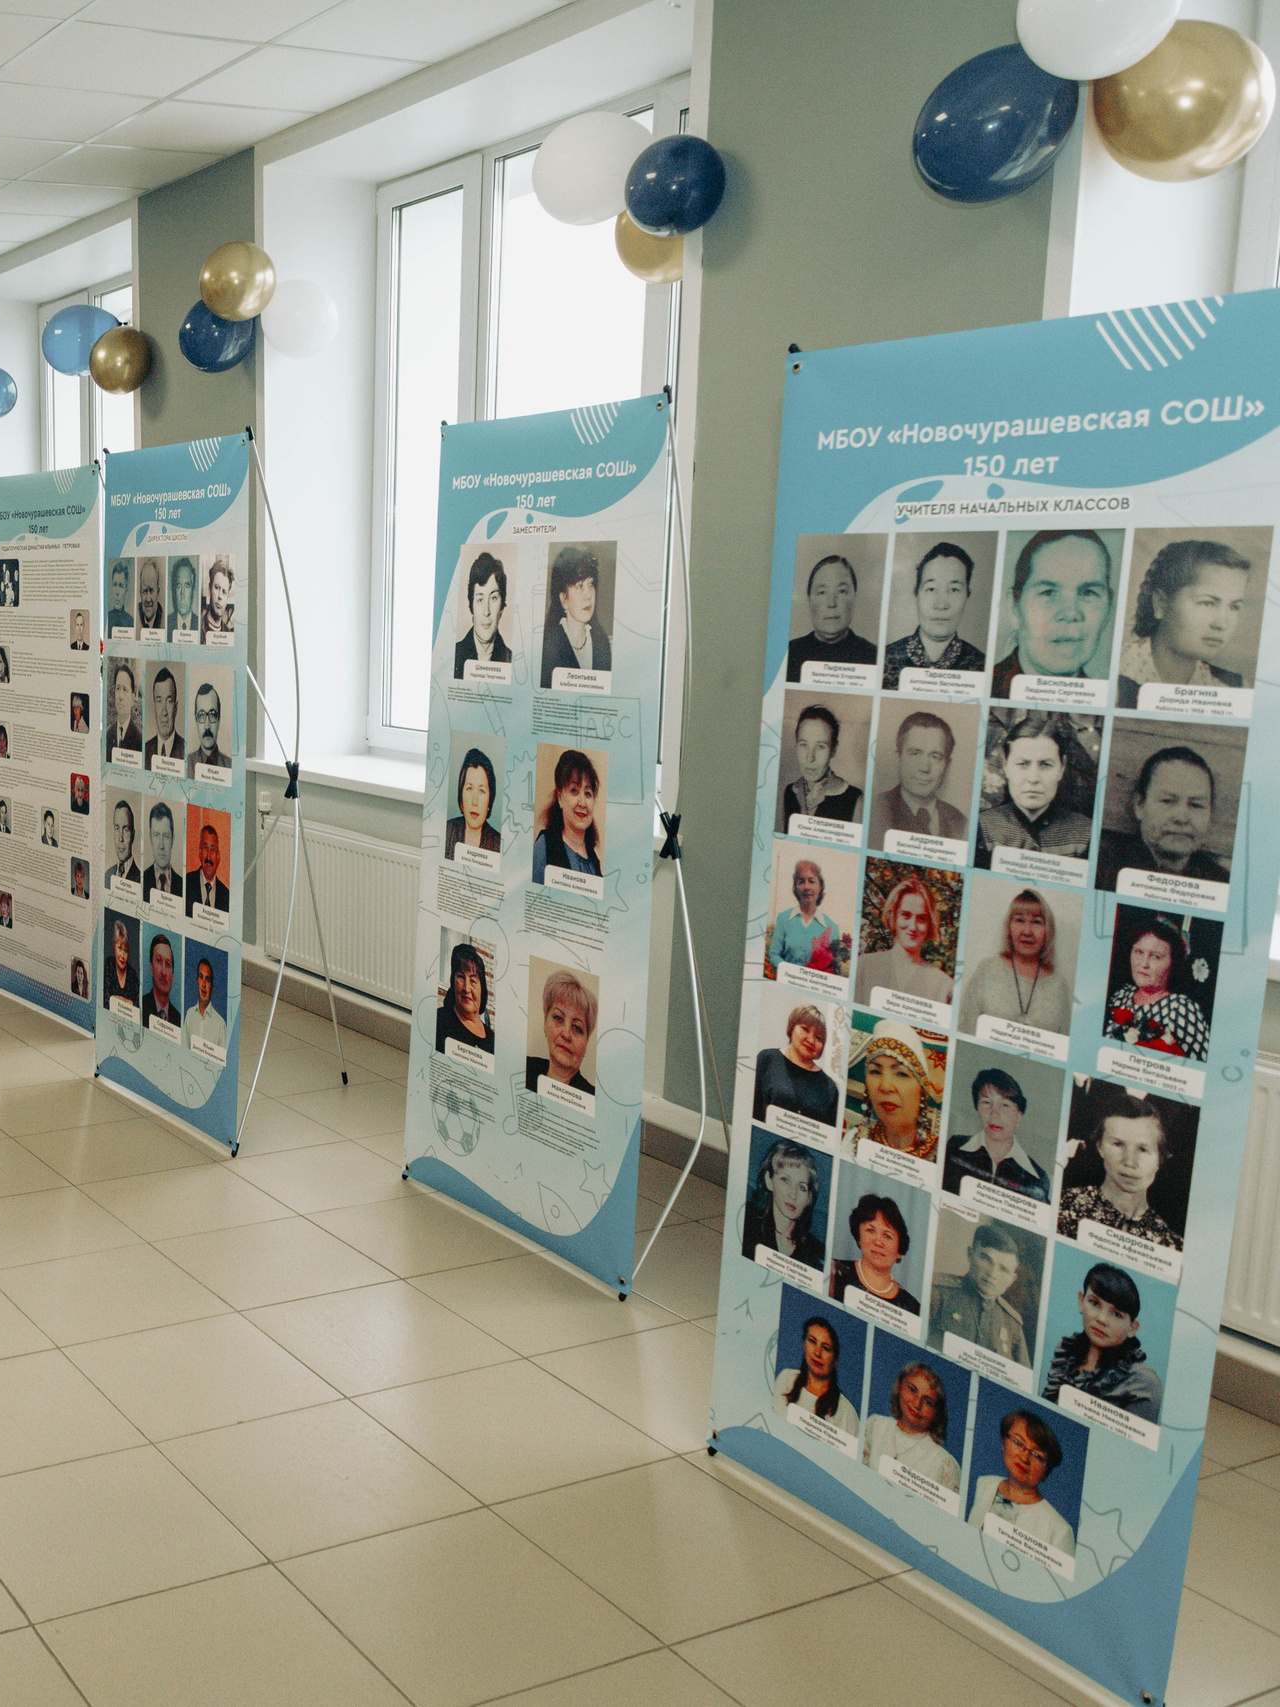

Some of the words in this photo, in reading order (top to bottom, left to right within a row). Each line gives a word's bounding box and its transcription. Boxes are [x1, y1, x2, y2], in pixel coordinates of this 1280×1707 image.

[817, 426, 882, 451] МБОУ
[887, 406, 1150, 446] «Новочурашевская
[1160, 396, 1265, 428] СОШ»
[964, 454, 1005, 478] 150
[1013, 452, 1060, 476] лет
[452, 474, 481, 490] МБОУ
[483, 466, 592, 488] «Новочурашевская
[596, 460, 637, 478] СОШ»
[111, 494, 131, 506] МБОУ
[132, 488, 205, 505] «Новочурашевская
[207, 483, 232, 498] СОШ»
[516, 495, 534, 508] 150
[536, 495, 556, 508] лет
[12, 506, 66, 521] «Новочурашевская
[66, 504, 86, 515] СОШ»
[154, 508, 166, 520] 150
[168, 508, 181, 519] лет
[896, 503, 956, 518] УЧИТЕЛЯ
[960, 500, 1049, 516] НАЧАЛЬНЫХ
[1053, 497, 1130, 513] КЛАССОВ
[28, 525, 38, 534] 150
[38, 524, 48, 533] лет
[513, 525, 557, 535] ЗАМЕСТИТЕЛИ
[148, 534, 171, 543] ДИРЕКТОРА
[567, 672, 597, 682] Леонтьева
[924, 670, 961, 680] Тарасова
[1037, 678, 1084, 689] Васильева
[1174, 687, 1218, 699] Брагина
[1191, 698, 1232, 708] Ивановна
[808, 818, 844, 830] Степанова
[910, 835, 944, 846] Андреев
[562, 872, 586, 884] Иванова
[1147, 873, 1200, 890] Федорова
[1130, 882, 1168, 895] Антонина
[1170, 887, 1216, 902] Федоровна
[799, 968, 828, 981] Петрова
[891, 993, 933, 1009] Николаева
[1007, 1022, 1040, 1038] Рузаева
[1112, 1061, 1140, 1074] Марина
[1142, 1067, 1188, 1085] Витальевна
[1129, 1055, 1171, 1073] Петрова
[552, 1083, 582, 1101] Максимова
[783, 1112, 820, 1130] Анисимова
[880, 1148, 916, 1164] Акчурина
[977, 1182, 1037, 1209] Александрова
[1088, 1232, 1120, 1248] Федосия
[1122, 1244, 1172, 1267] Афанасьевна
[1106, 1229, 1155, 1252] Сидорова
[773, 1252, 808, 1273] Николаева
[865, 1294, 902, 1317] Богданова
[974, 1349, 1006, 1369] Шашкин
[1073, 1399, 1101, 1419] Татьяна
[1102, 1413, 1146, 1438] Николаевна
[1090, 1398, 1130, 1422] Иванова
[810, 1414, 837, 1434] Иванова
[823, 1428, 847, 1447] Юрьевна
[900, 1466, 940, 1492] Фёдорова
[997, 1528, 1023, 1548] Татьяна
[1025, 1541, 1063, 1568] Васильевна
[1012, 1527, 1048, 1551] Козлова
